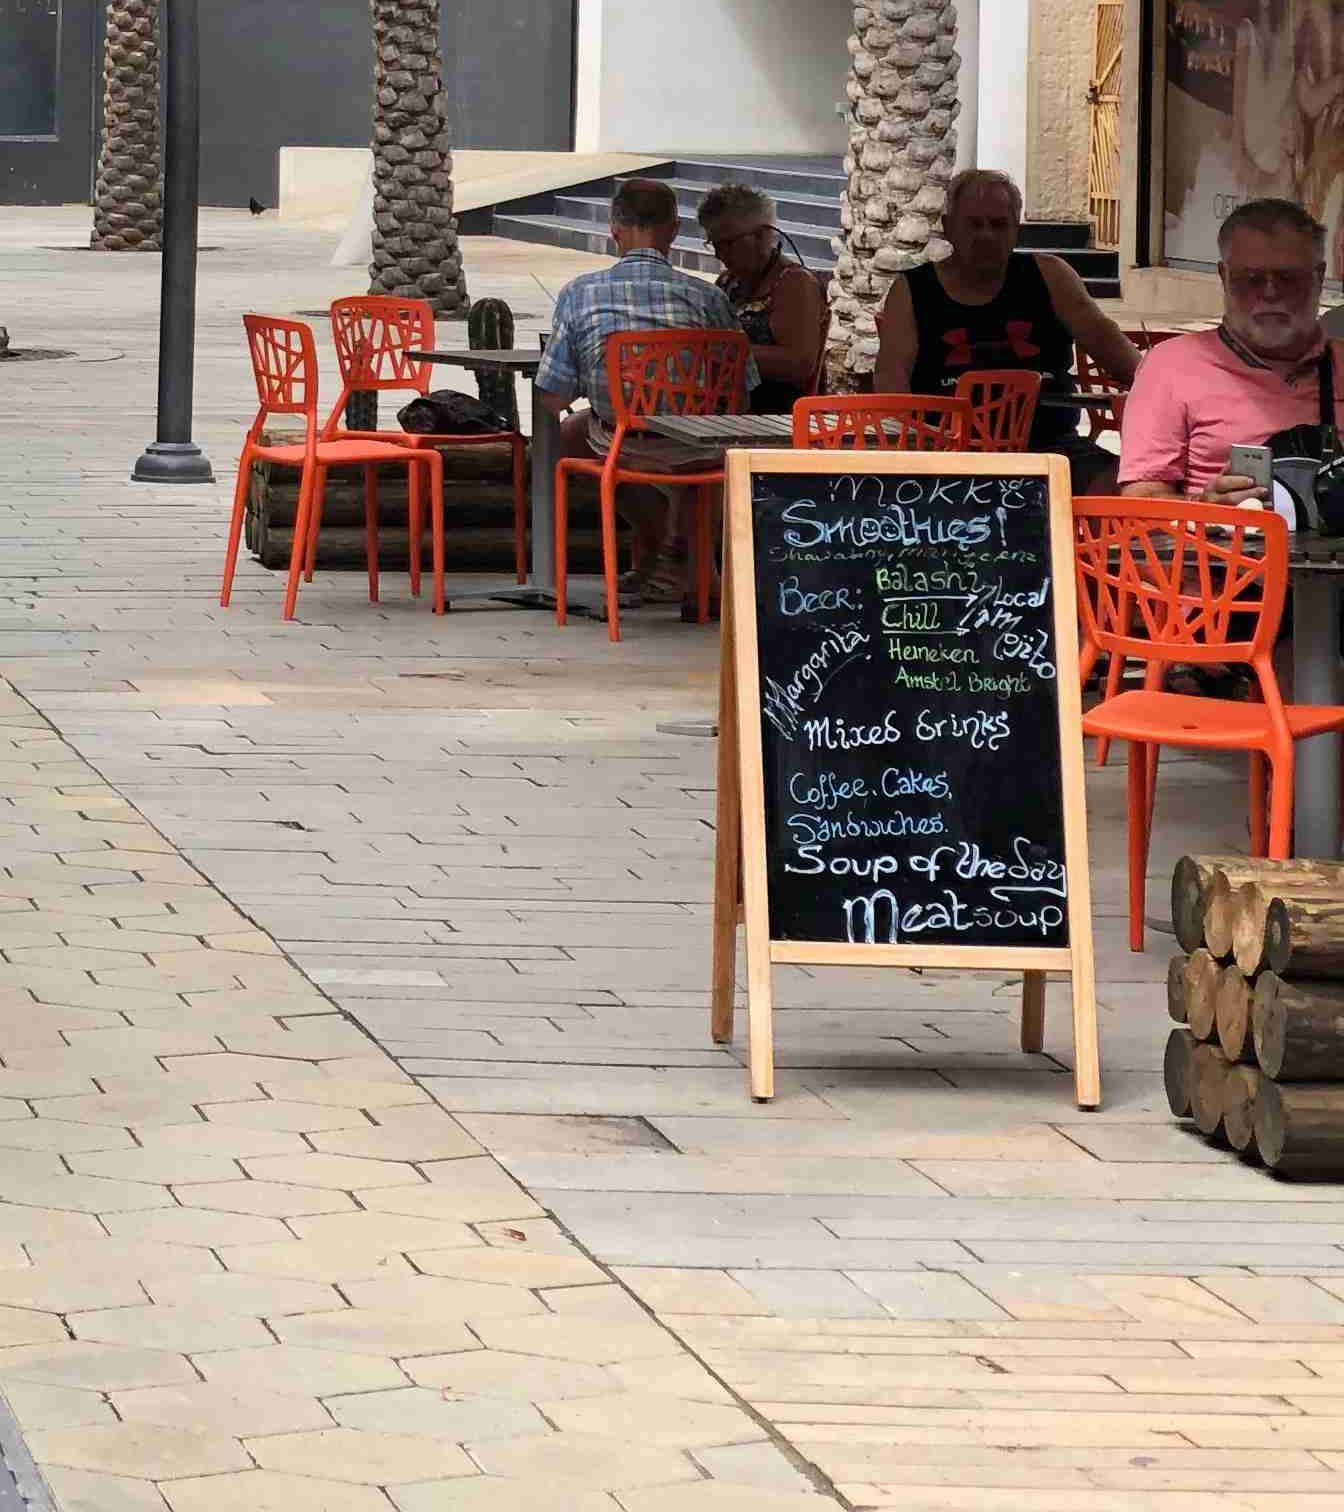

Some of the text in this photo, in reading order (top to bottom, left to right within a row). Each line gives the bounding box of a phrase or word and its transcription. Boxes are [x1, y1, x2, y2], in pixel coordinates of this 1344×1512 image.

[881, 601, 941, 631] Chill
[784, 844, 899, 882] Soup
[910, 846, 957, 882] of
[843, 889, 1064, 945] Meat soup
